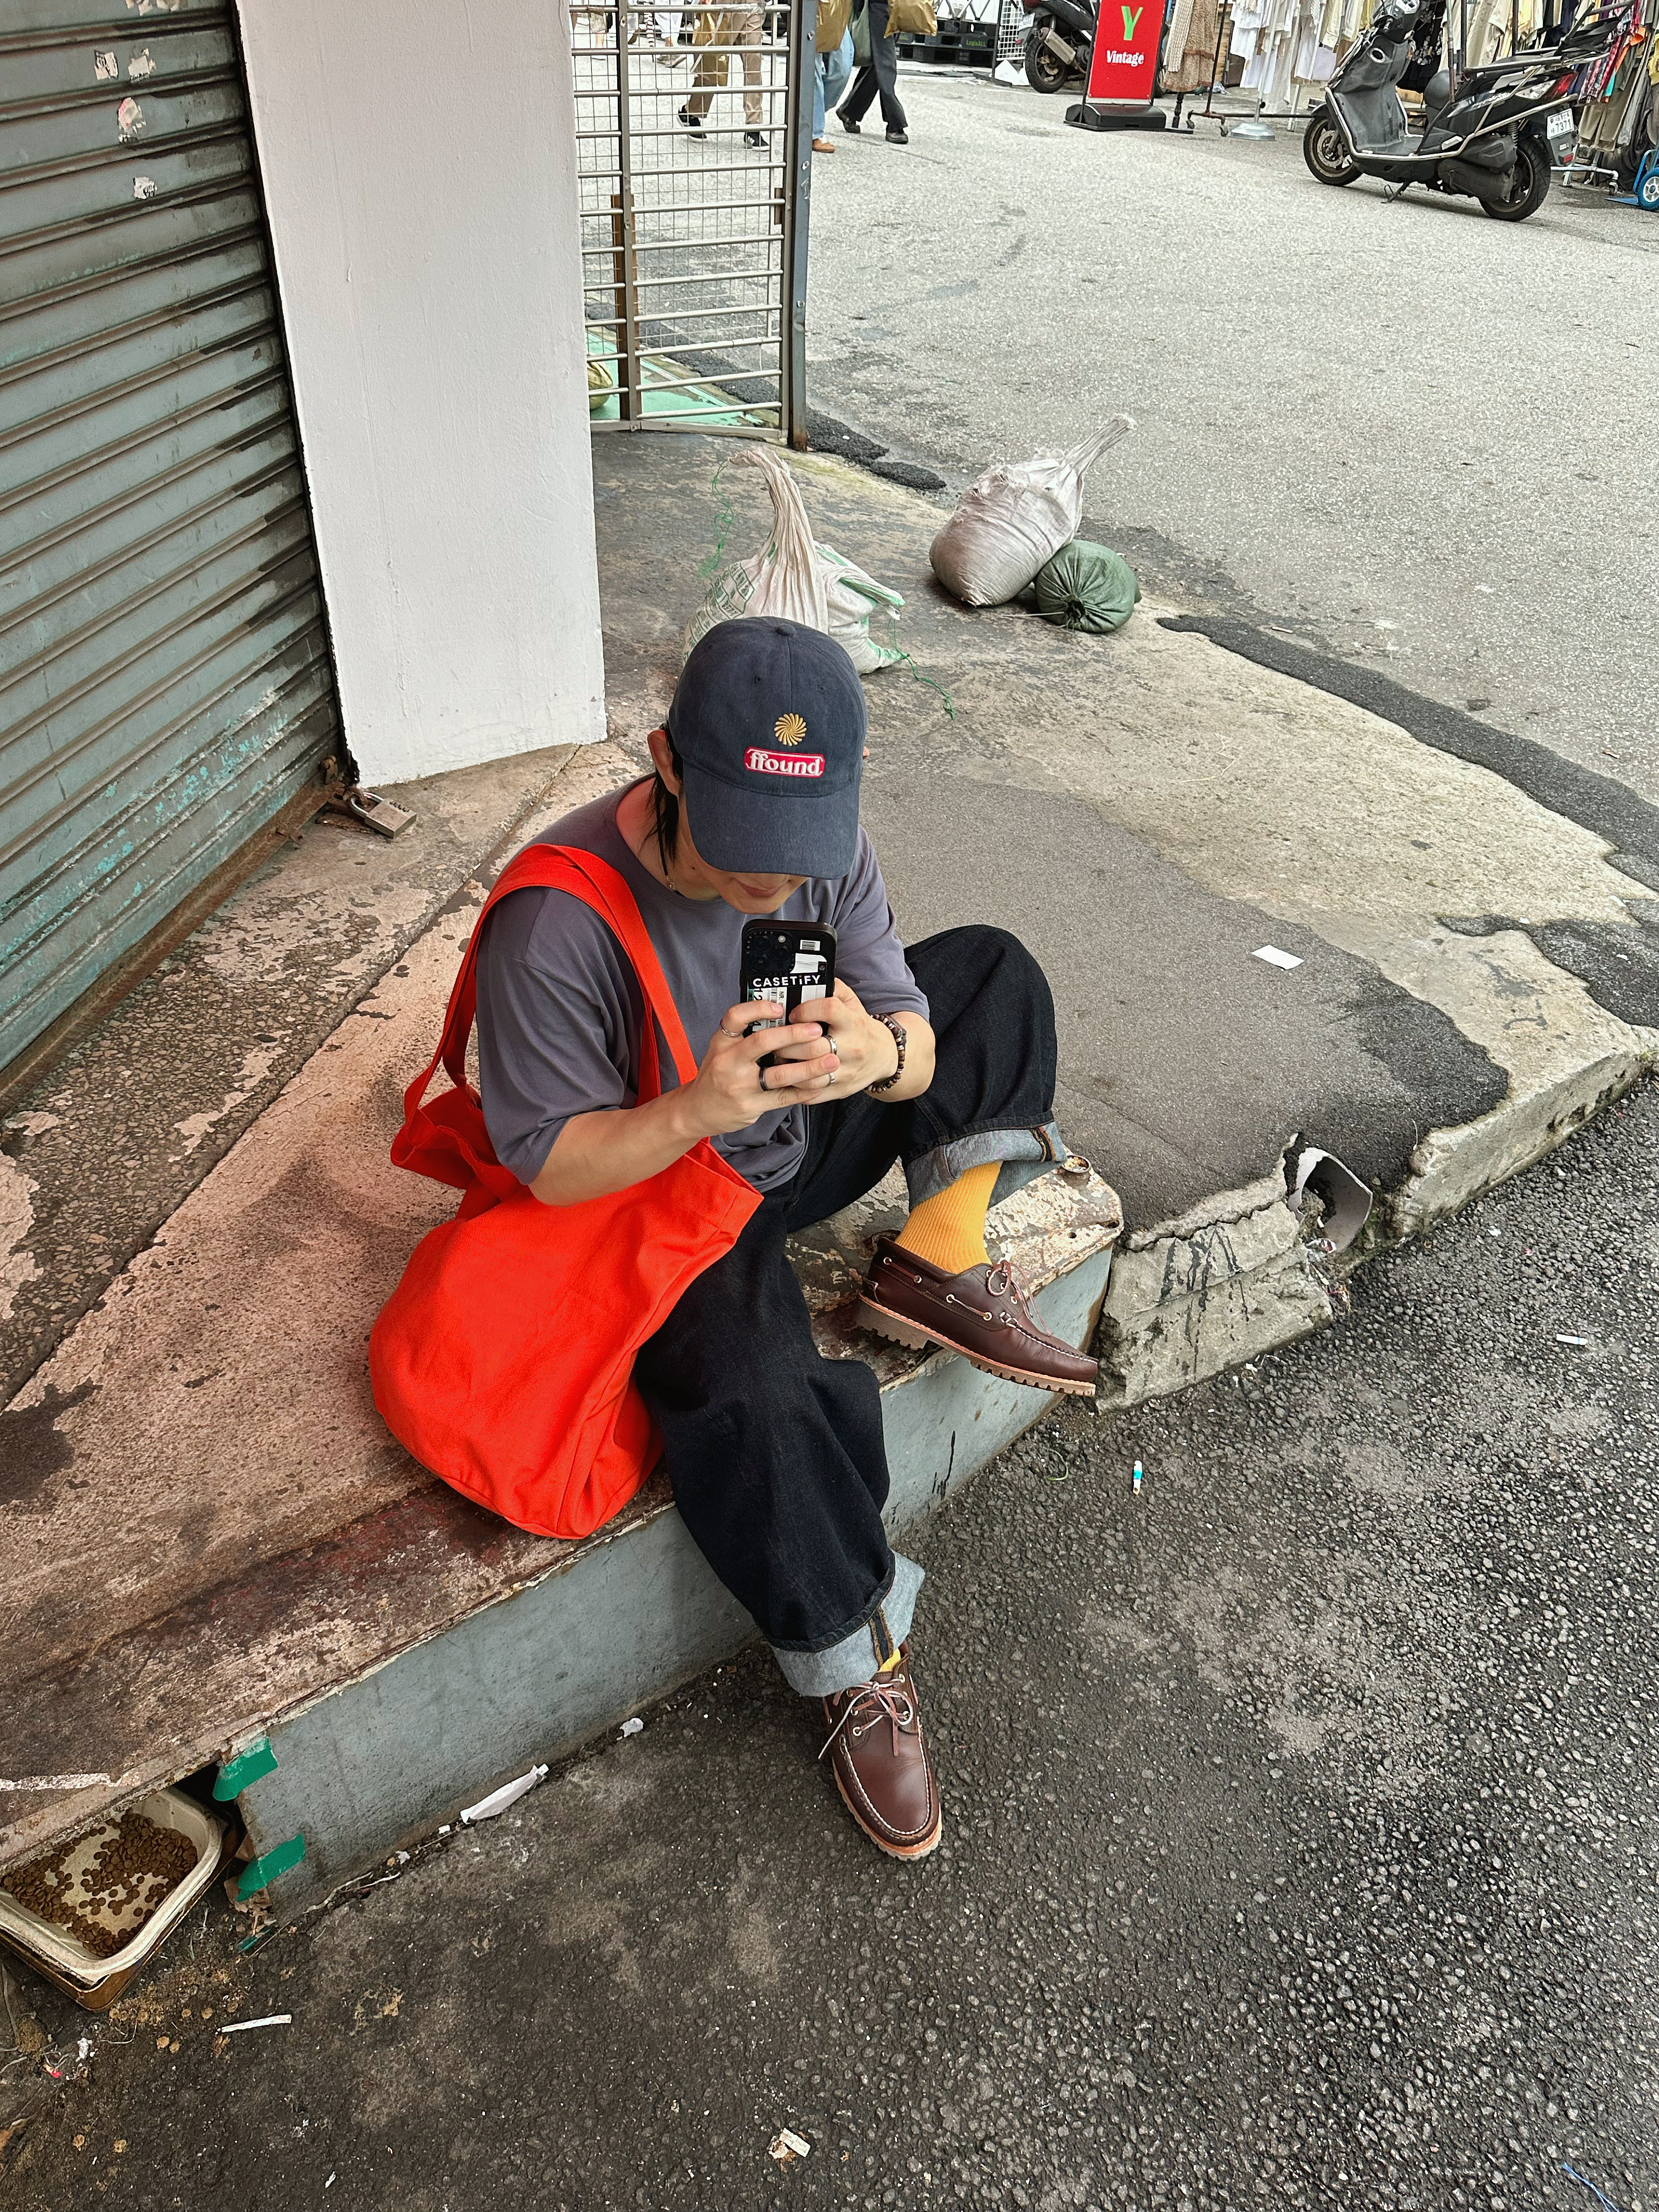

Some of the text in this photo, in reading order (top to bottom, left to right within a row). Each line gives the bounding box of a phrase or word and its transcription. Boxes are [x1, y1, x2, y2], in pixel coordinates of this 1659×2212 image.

[1121, 5, 1143, 41] Y
[1107, 50, 1144, 67] Vintage
[1555, 119, 1572, 133] 7371
[750, 752, 821, 775] ffound
